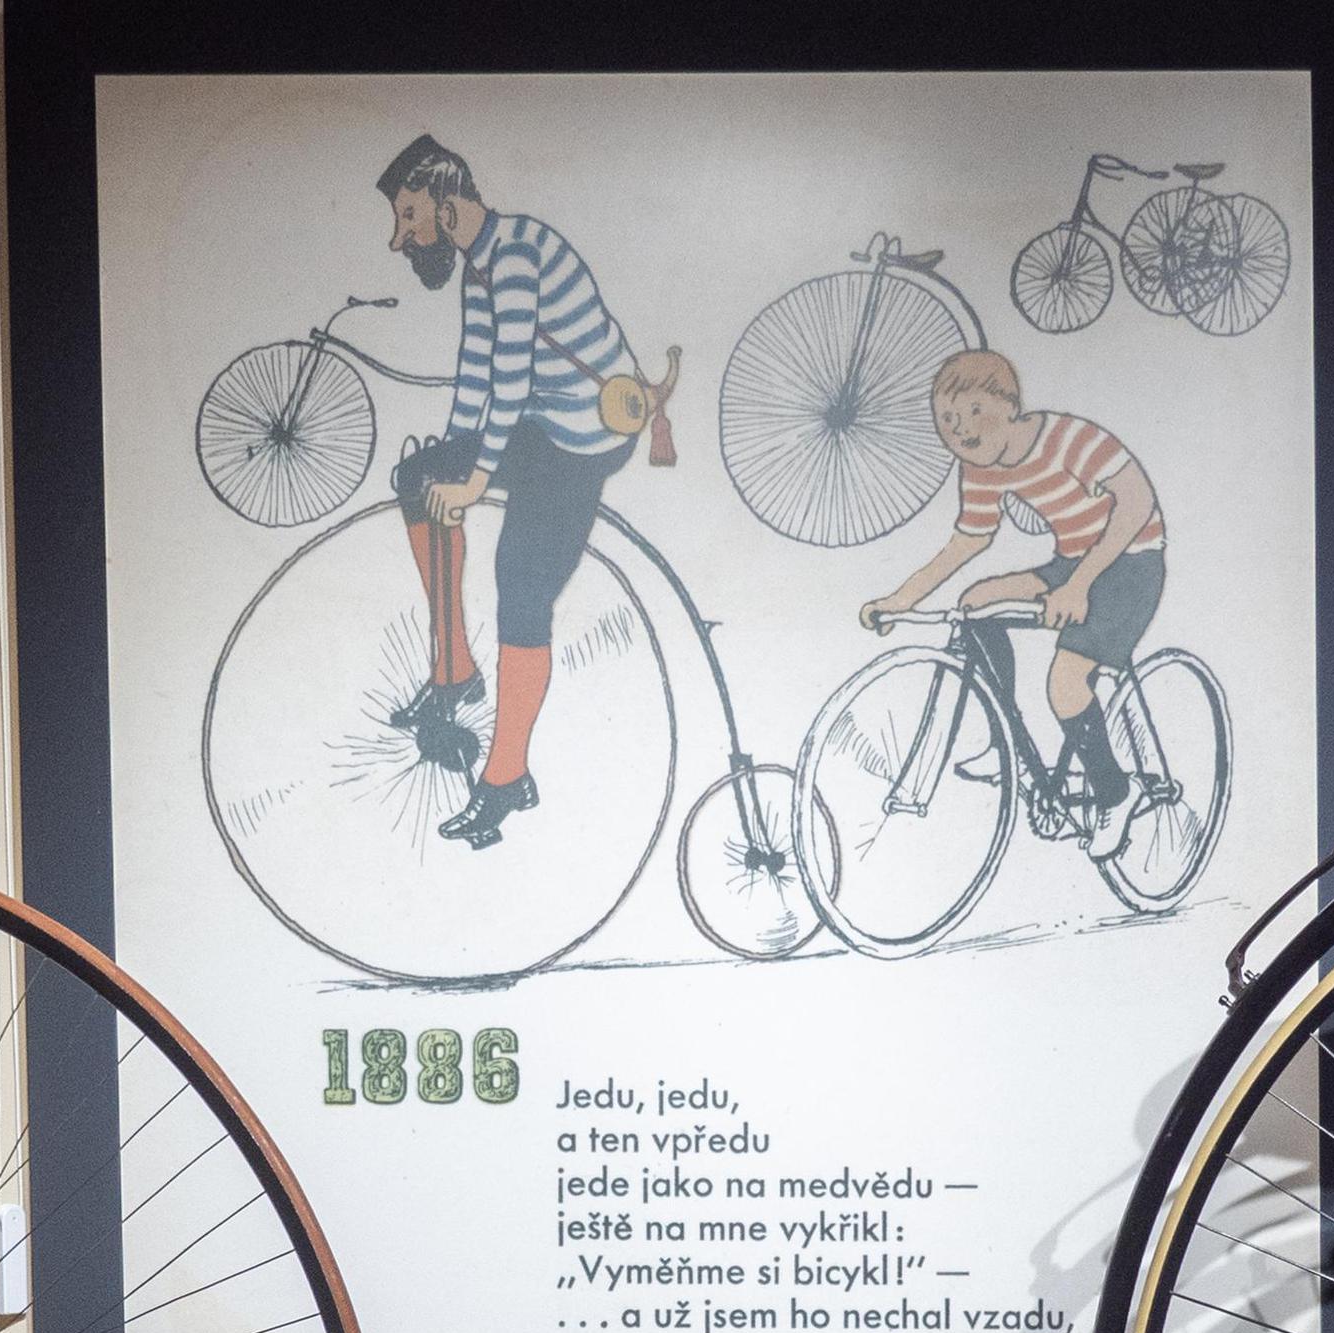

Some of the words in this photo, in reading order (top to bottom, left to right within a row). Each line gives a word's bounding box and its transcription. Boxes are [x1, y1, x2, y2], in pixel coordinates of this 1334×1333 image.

[322, 1027, 520, 1105] 1886
[555, 1077, 644, 1114] Jedu,
[658, 1077, 739, 1116] jedu,
[556, 1132, 576, 1153] a
[588, 1126, 639, 1154] ten
[651, 1122, 769, 1161] vpředu
[557, 1165, 629, 1204] jede
[642, 1165, 713, 1204] jako
[726, 1177, 765, 1198] na
[779, 1165, 932, 1199] medvědu
[557, 1210, 633, 1247] ještě
[645, 1221, 685, 1241] na
[699, 1221, 767, 1241] mne
[757, 1255, 780, 1285] si
[620, 1308, 640, 1328] a
[654, 1300, 691, 1328] už
[790, 1297, 830, 1329] ho
[843, 1297, 950, 1329] nechal
